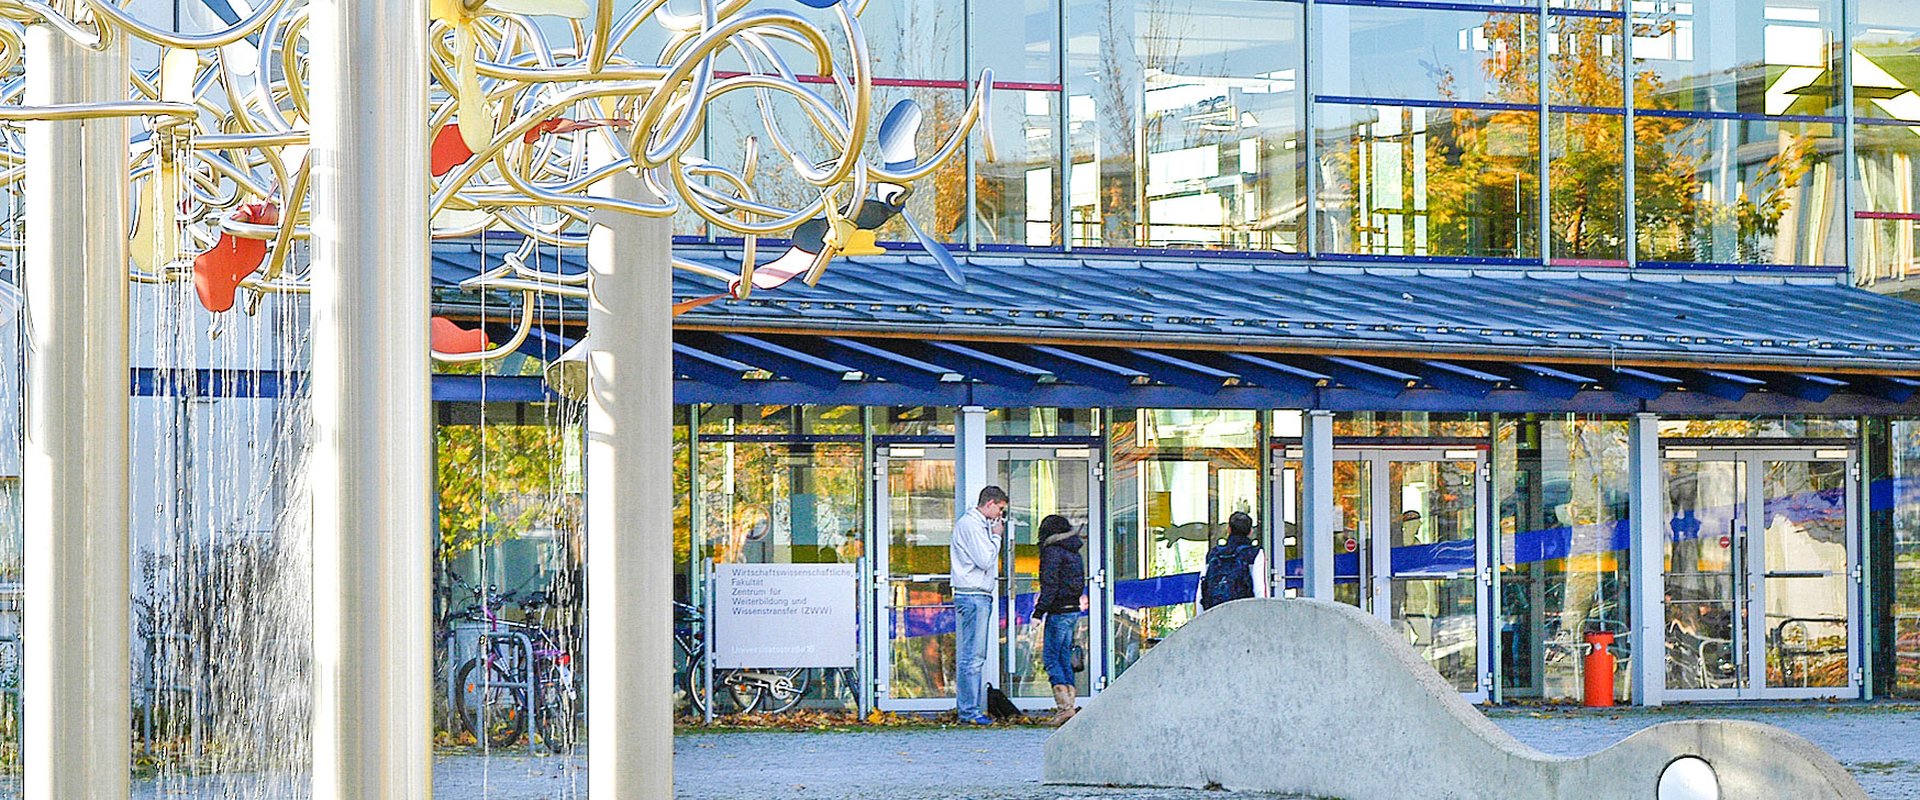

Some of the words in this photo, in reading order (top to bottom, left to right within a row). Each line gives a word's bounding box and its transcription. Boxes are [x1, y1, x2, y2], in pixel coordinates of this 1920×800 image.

[731, 578, 764, 586] Fakultät
[731, 588, 767, 596] Zentrum
[769, 588, 782, 596] für
[732, 597, 789, 606] Weiterbildung
[791, 597, 807, 605] und
[732, 607, 798, 615] Wissenstransfer
[800, 607, 833, 615] (ZWW)
